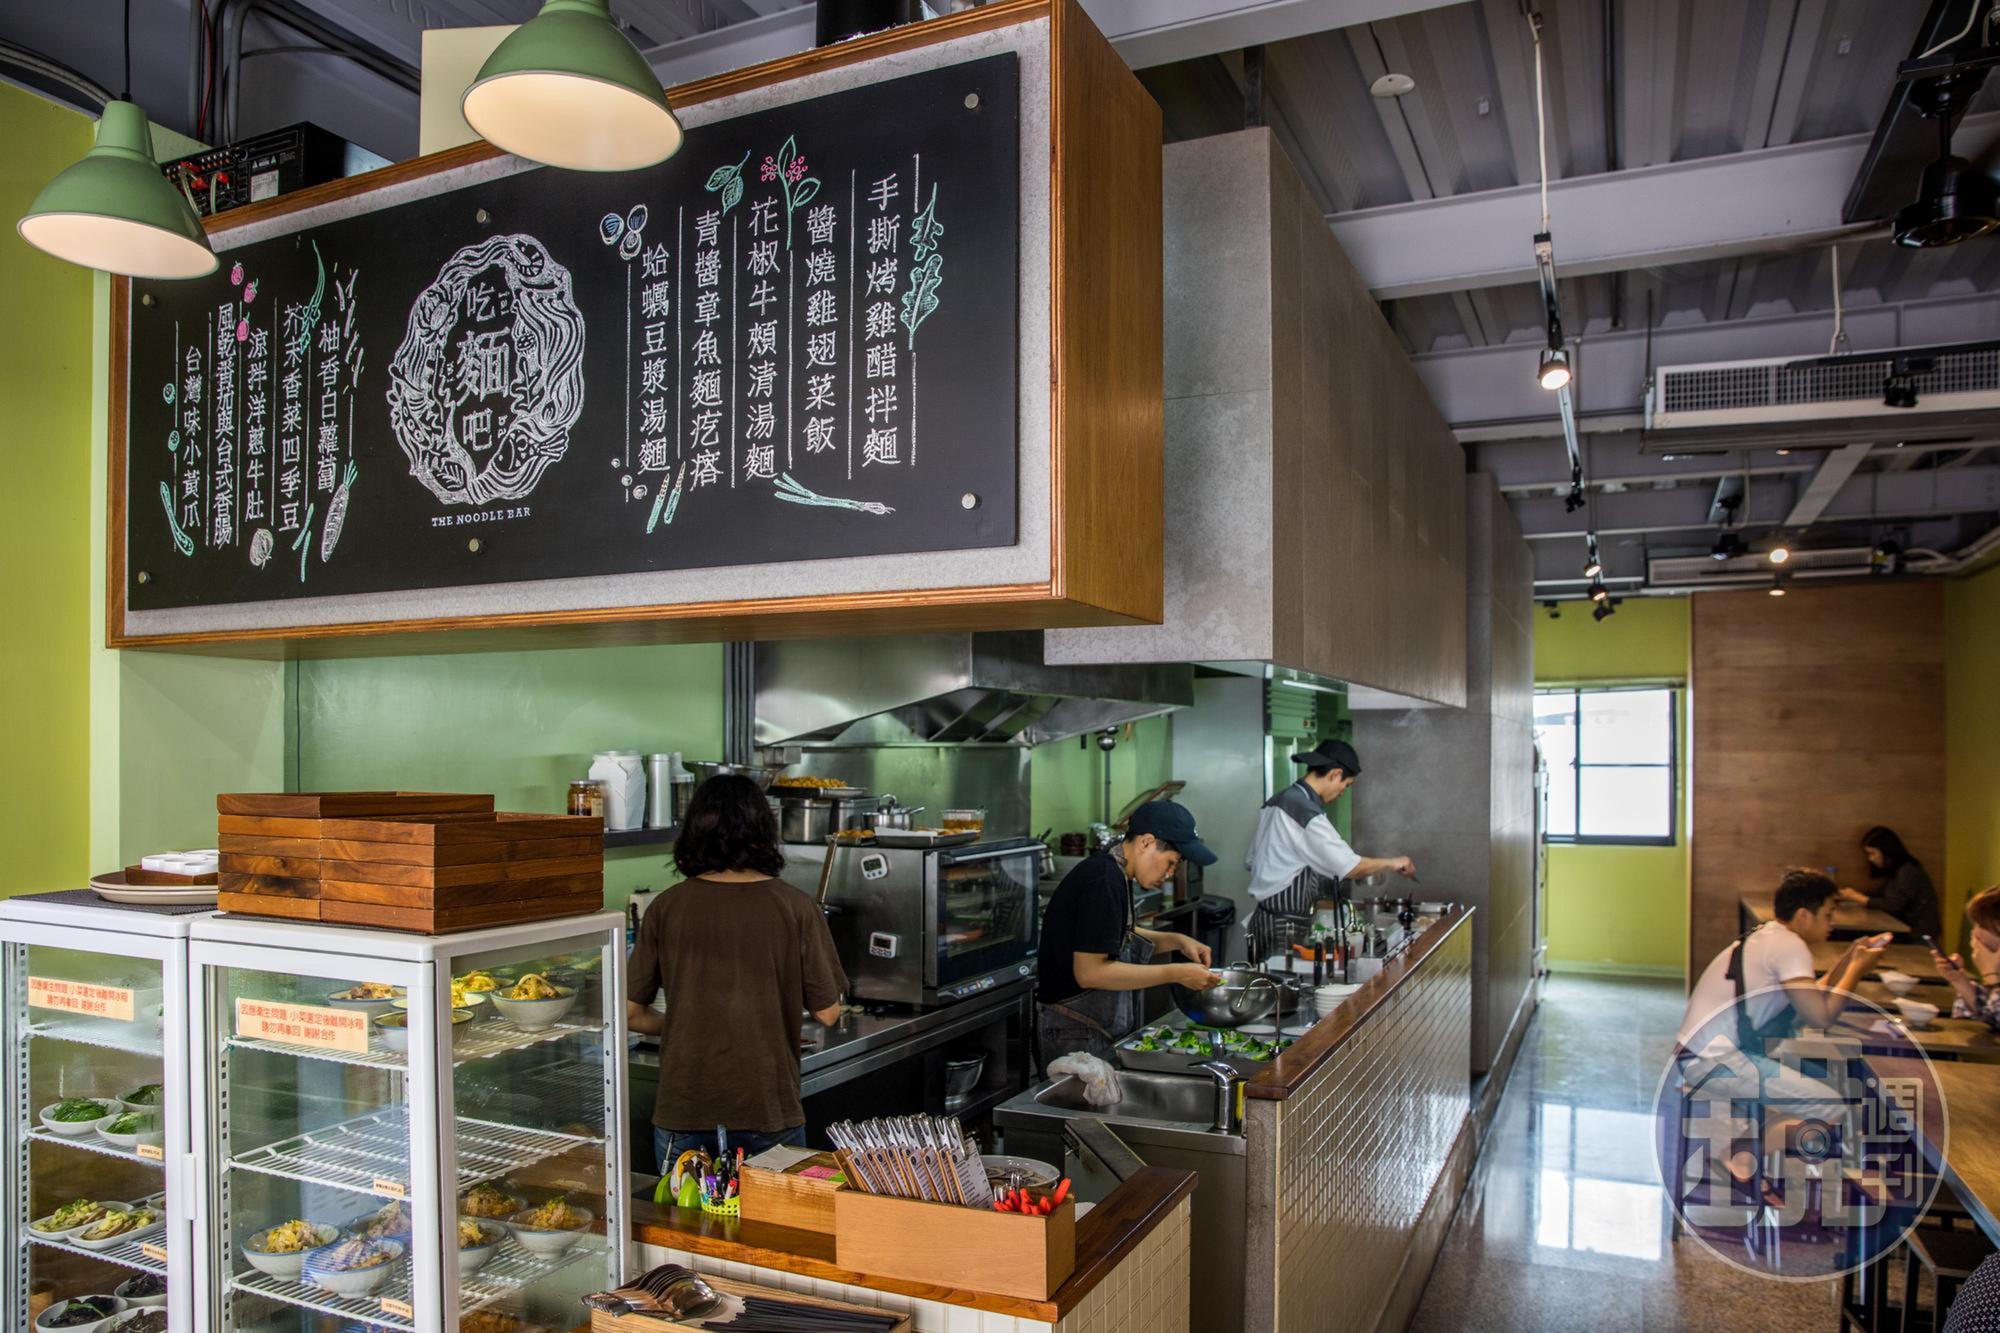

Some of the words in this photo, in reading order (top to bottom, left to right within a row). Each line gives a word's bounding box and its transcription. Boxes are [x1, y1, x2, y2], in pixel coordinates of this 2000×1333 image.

[278, 302, 304, 533] 芥末香菜四季豆
[316, 319, 341, 494] 柚香白蘿蔔
[456, 282, 511, 452] 吃麵吧
[637, 241, 671, 475] 蛤蠣豆漿湯麵
[688, 209, 725, 492] 青醬章魚麵疙瘩
[743, 196, 781, 481] 花椒牛頰清湯麵
[802, 205, 838, 455] 醬燒雞翅菜飯
[862, 173, 901, 468] 手撕烤雞醋拌麵
[181, 345, 202, 530] 台灣味小黃瓜
[431, 516, 453, 527] THE
[456, 510, 504, 525] NOODLE
[507, 507, 531, 519] BAR
